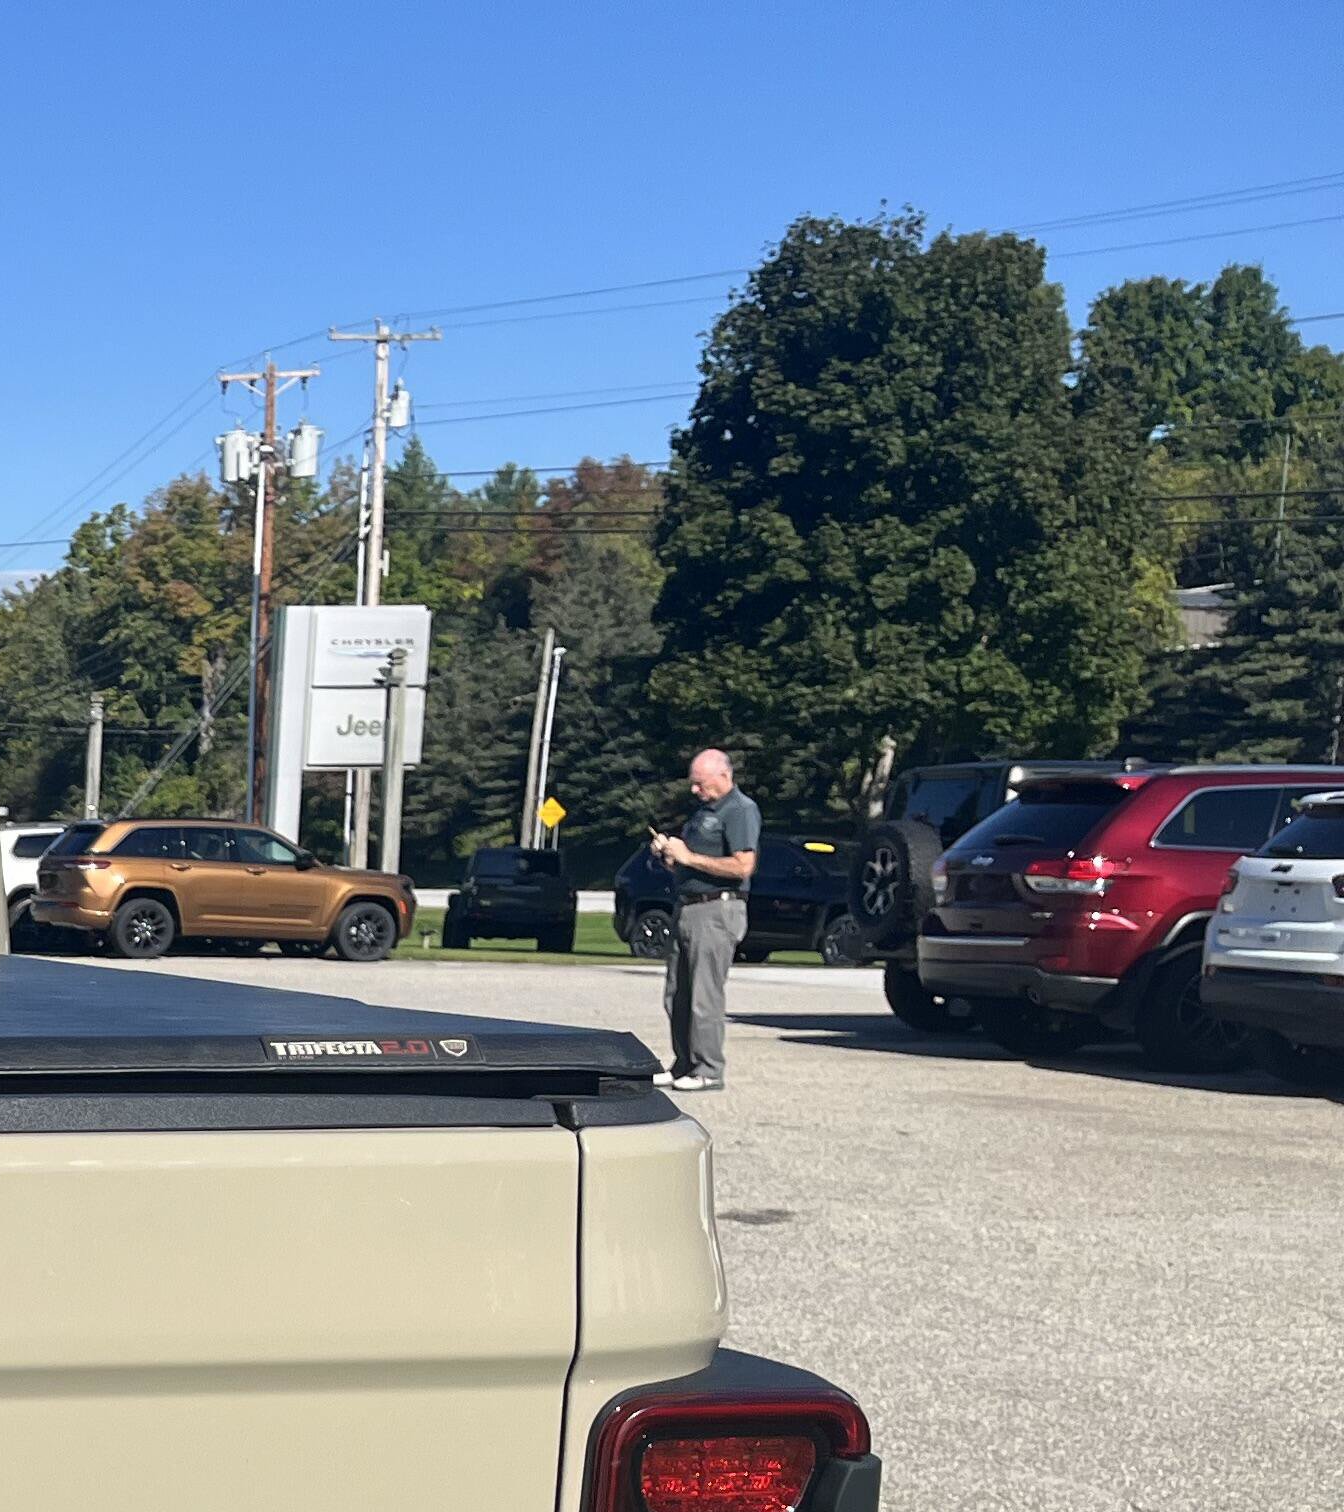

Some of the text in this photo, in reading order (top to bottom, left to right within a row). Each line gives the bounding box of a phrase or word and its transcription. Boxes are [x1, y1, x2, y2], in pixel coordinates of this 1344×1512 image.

[335, 714, 384, 737] Jee
[269, 1040, 382, 1056] TRIFECTA
[379, 1040, 430, 1055] 2.0
